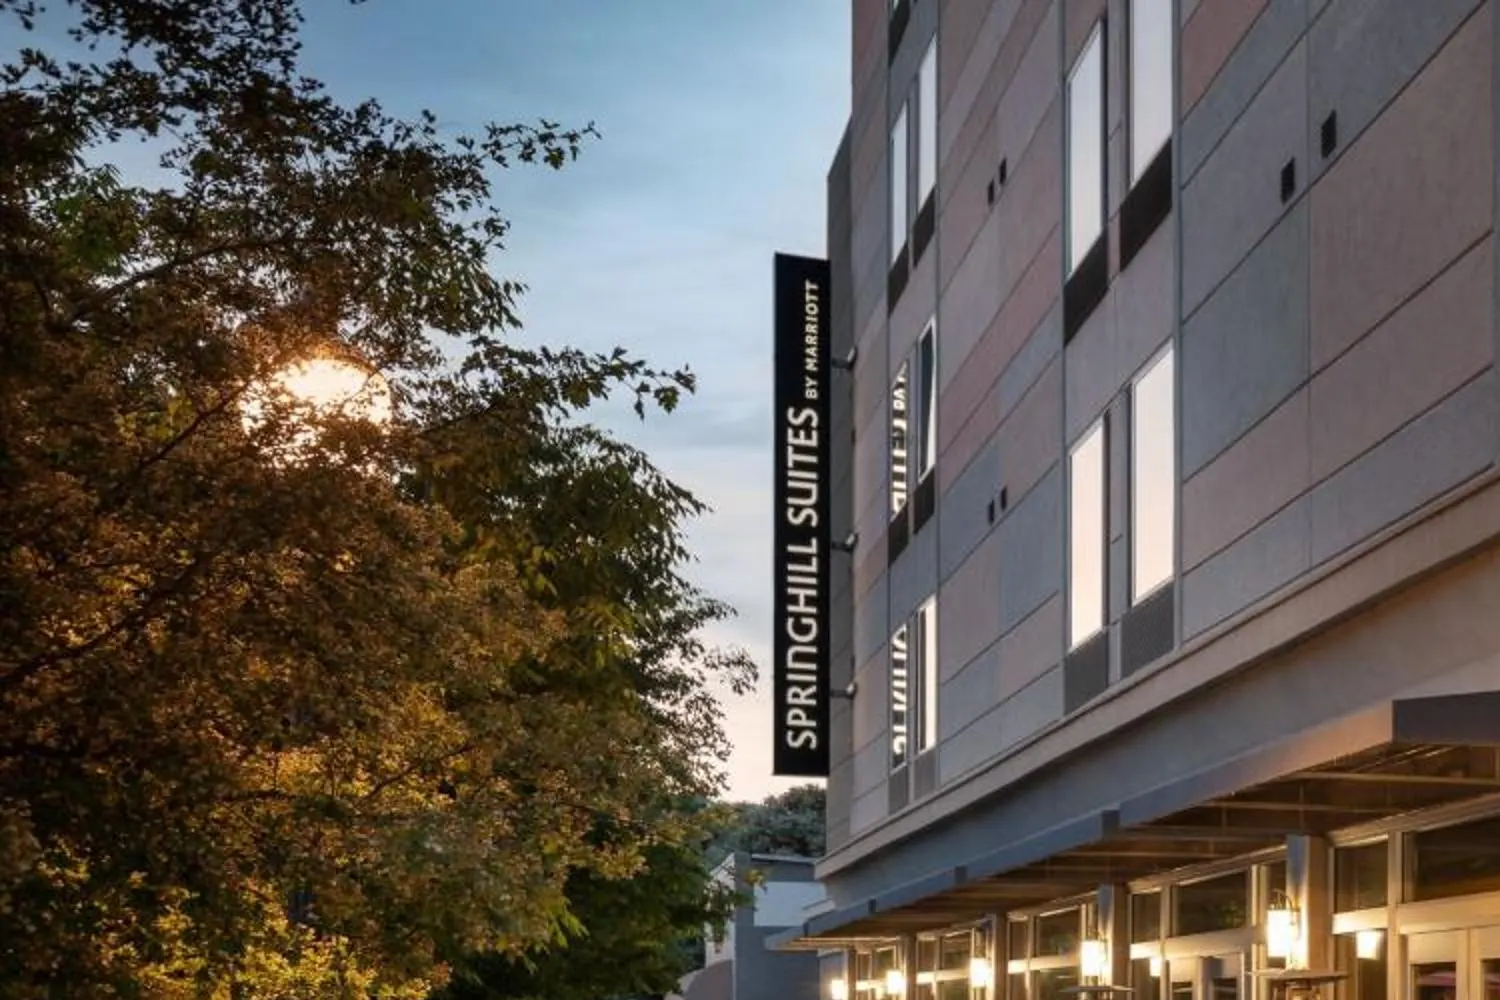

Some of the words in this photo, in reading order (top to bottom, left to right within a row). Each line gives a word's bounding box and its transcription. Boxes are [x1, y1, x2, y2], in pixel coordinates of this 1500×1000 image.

[805, 279, 819, 371] MARRIOTT
[805, 377, 819, 399] BY
[787, 407, 819, 527] SUITES
[786, 537, 818, 750] SPRINGHILL
